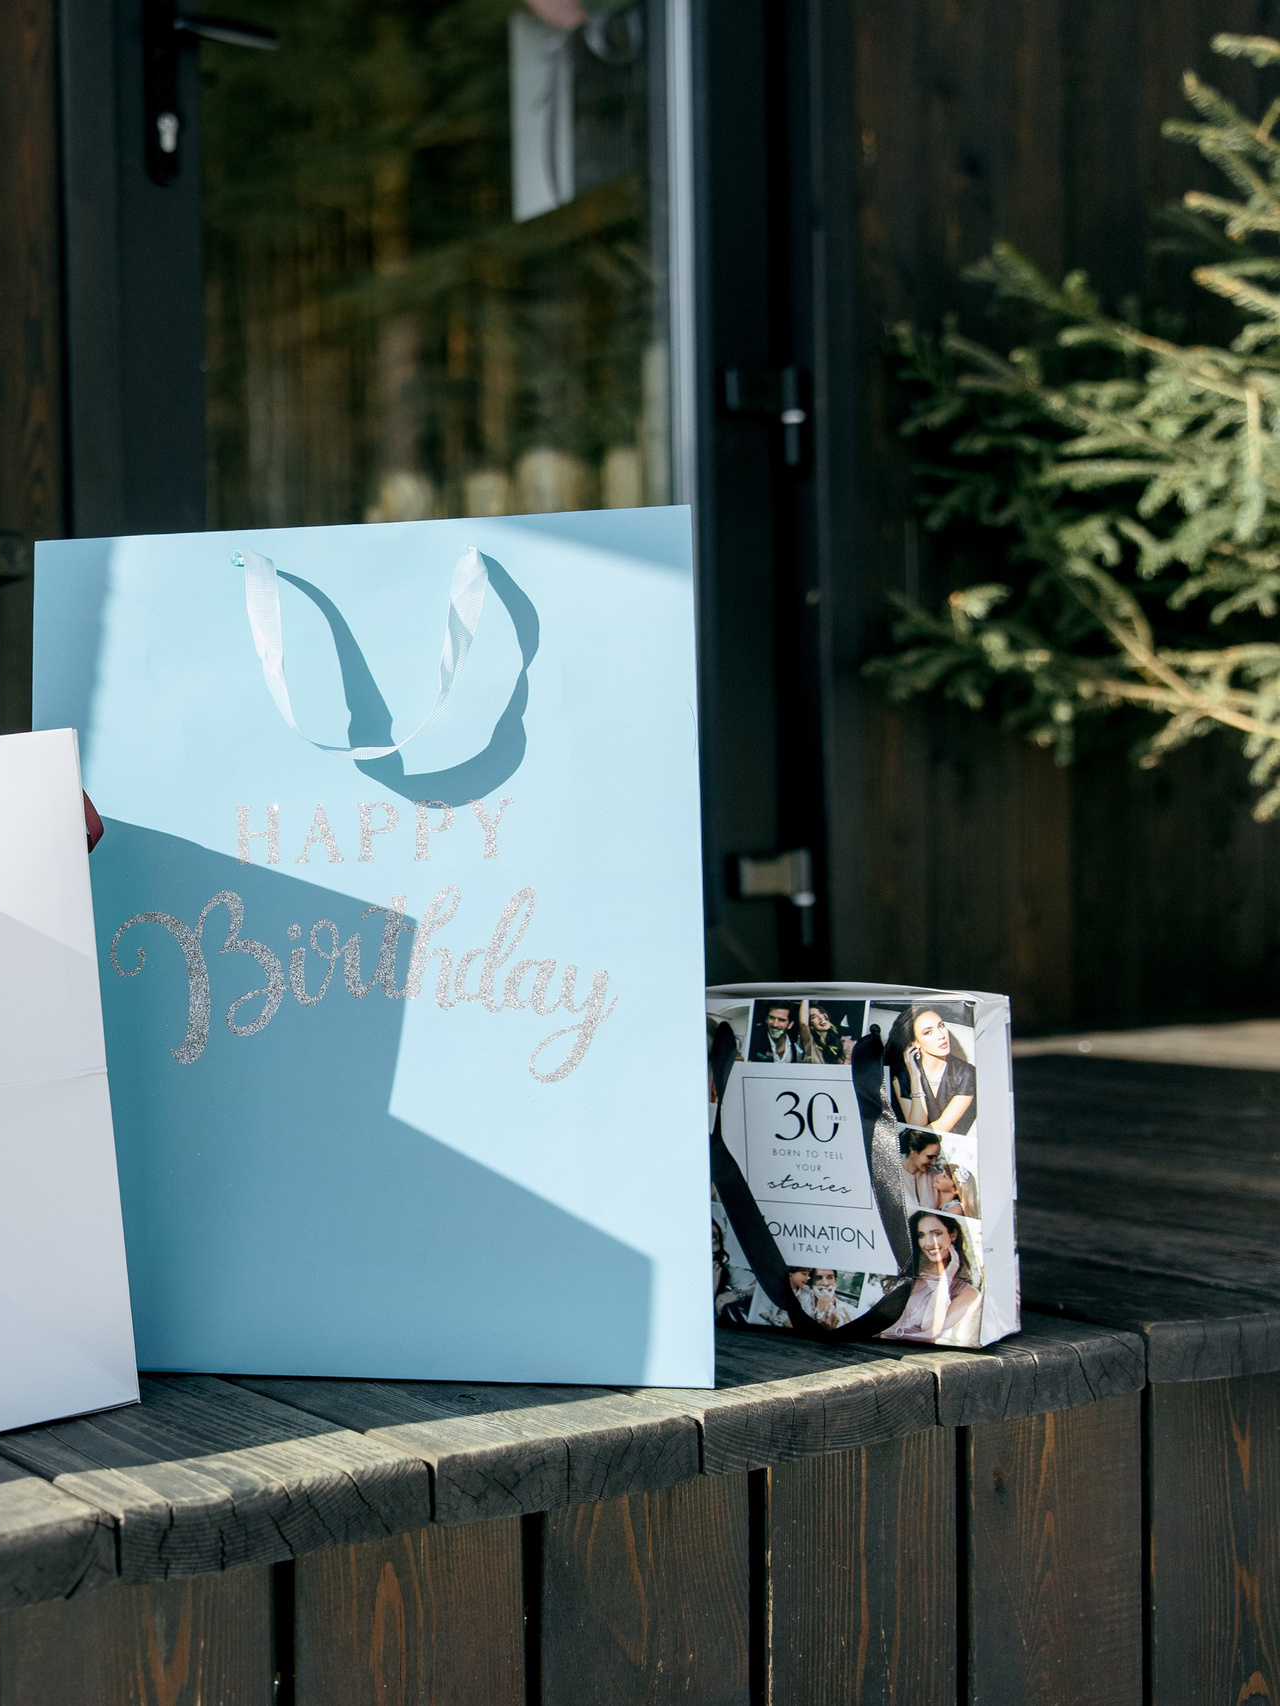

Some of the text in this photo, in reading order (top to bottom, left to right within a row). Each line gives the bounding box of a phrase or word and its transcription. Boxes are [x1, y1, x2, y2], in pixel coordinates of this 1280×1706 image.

[235, 797, 516, 865] HAPPY
[109, 884, 619, 1084] Birthday
[775, 1090, 839, 1143] 30
[826, 1114, 847, 1122] YEARS
[772, 1148, 844, 1160] BORN TO TELL
[796, 1163, 822, 1172] YOUR
[767, 1174, 852, 1194] stories
[763, 1215, 875, 1250] OMINATION
[793, 1243, 830, 1254] ITALY
